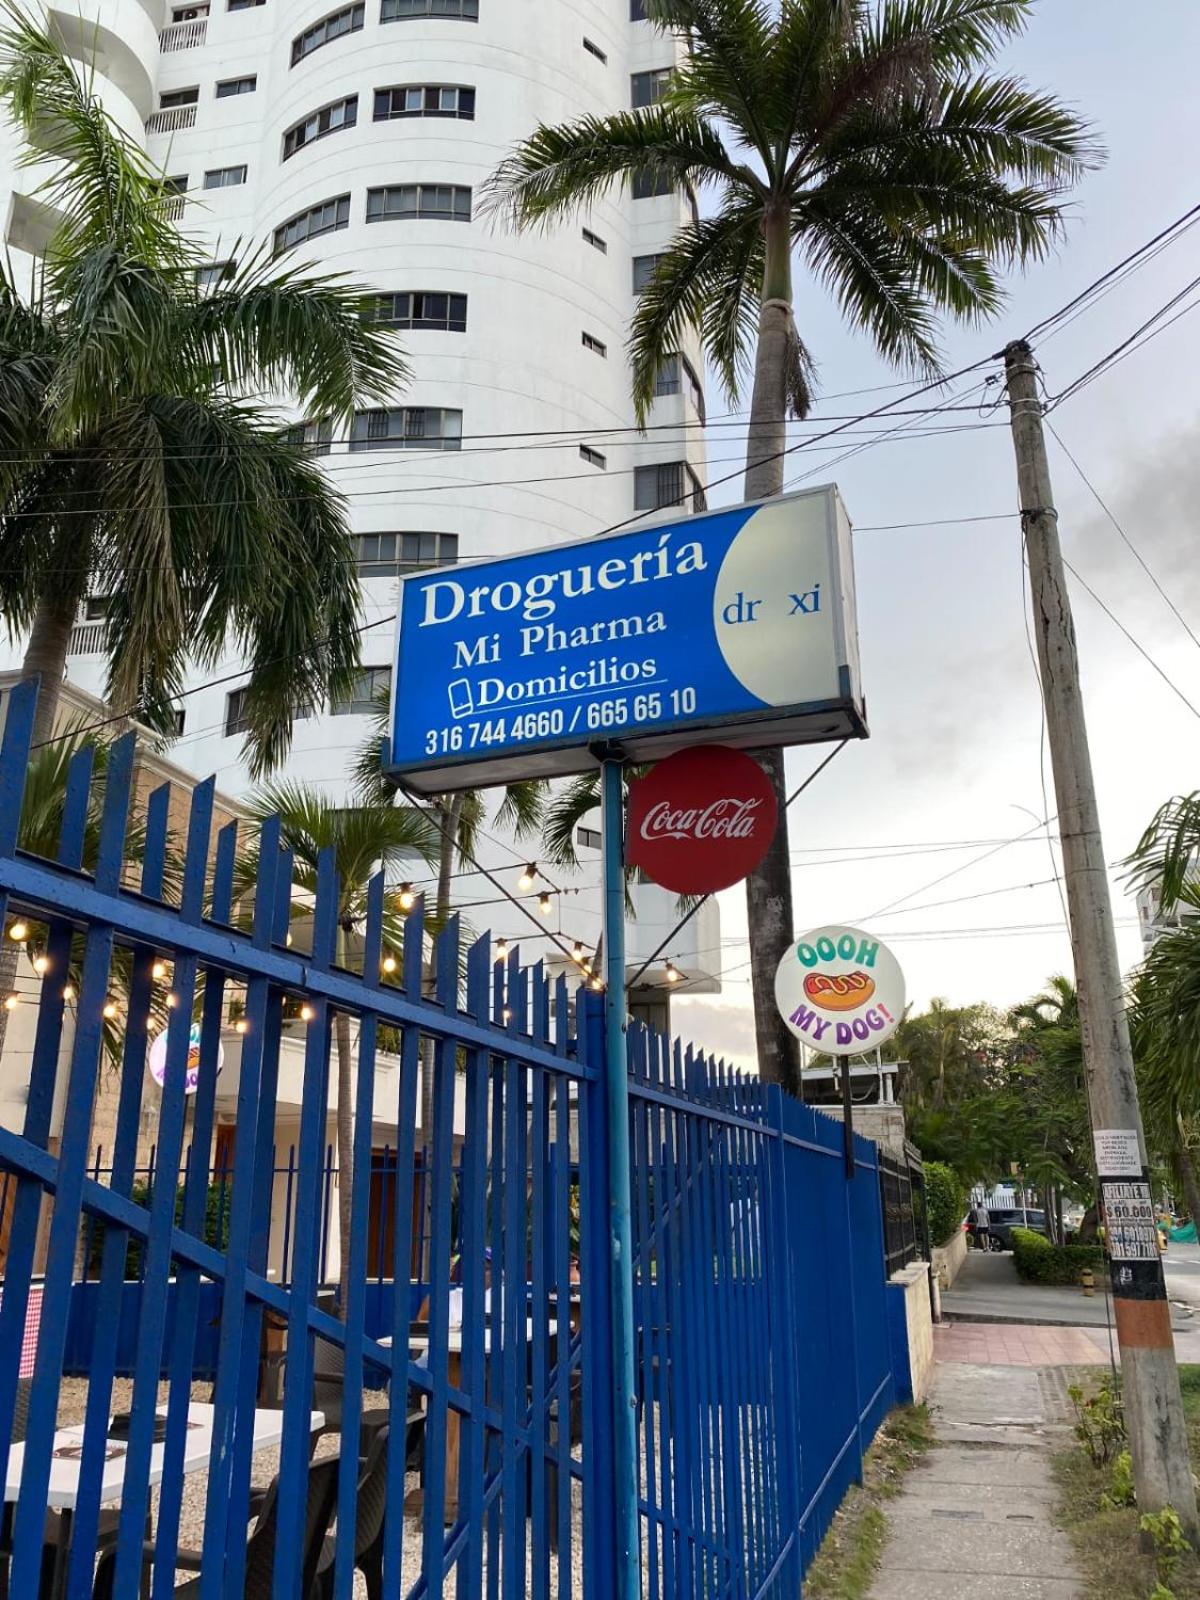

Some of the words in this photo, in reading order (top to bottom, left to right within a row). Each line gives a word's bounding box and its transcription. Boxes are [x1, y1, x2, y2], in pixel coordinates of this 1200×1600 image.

[419, 534, 708, 627] Droguería
[452, 634, 500, 670] Mi
[519, 610, 667, 657] Pharma
[476, 656, 657, 707] Domicilios
[425, 724, 463, 755] 316
[468, 720, 506, 749] 744
[510, 709, 564, 742] 4660
[586, 699, 628, 730] 665
[633, 694, 662, 722] 65
[671, 687, 696, 716] 10
[796, 934, 880, 968] OOOH
[788, 1003, 833, 1041] MY
[835, 1002, 896, 1046] DOG!
